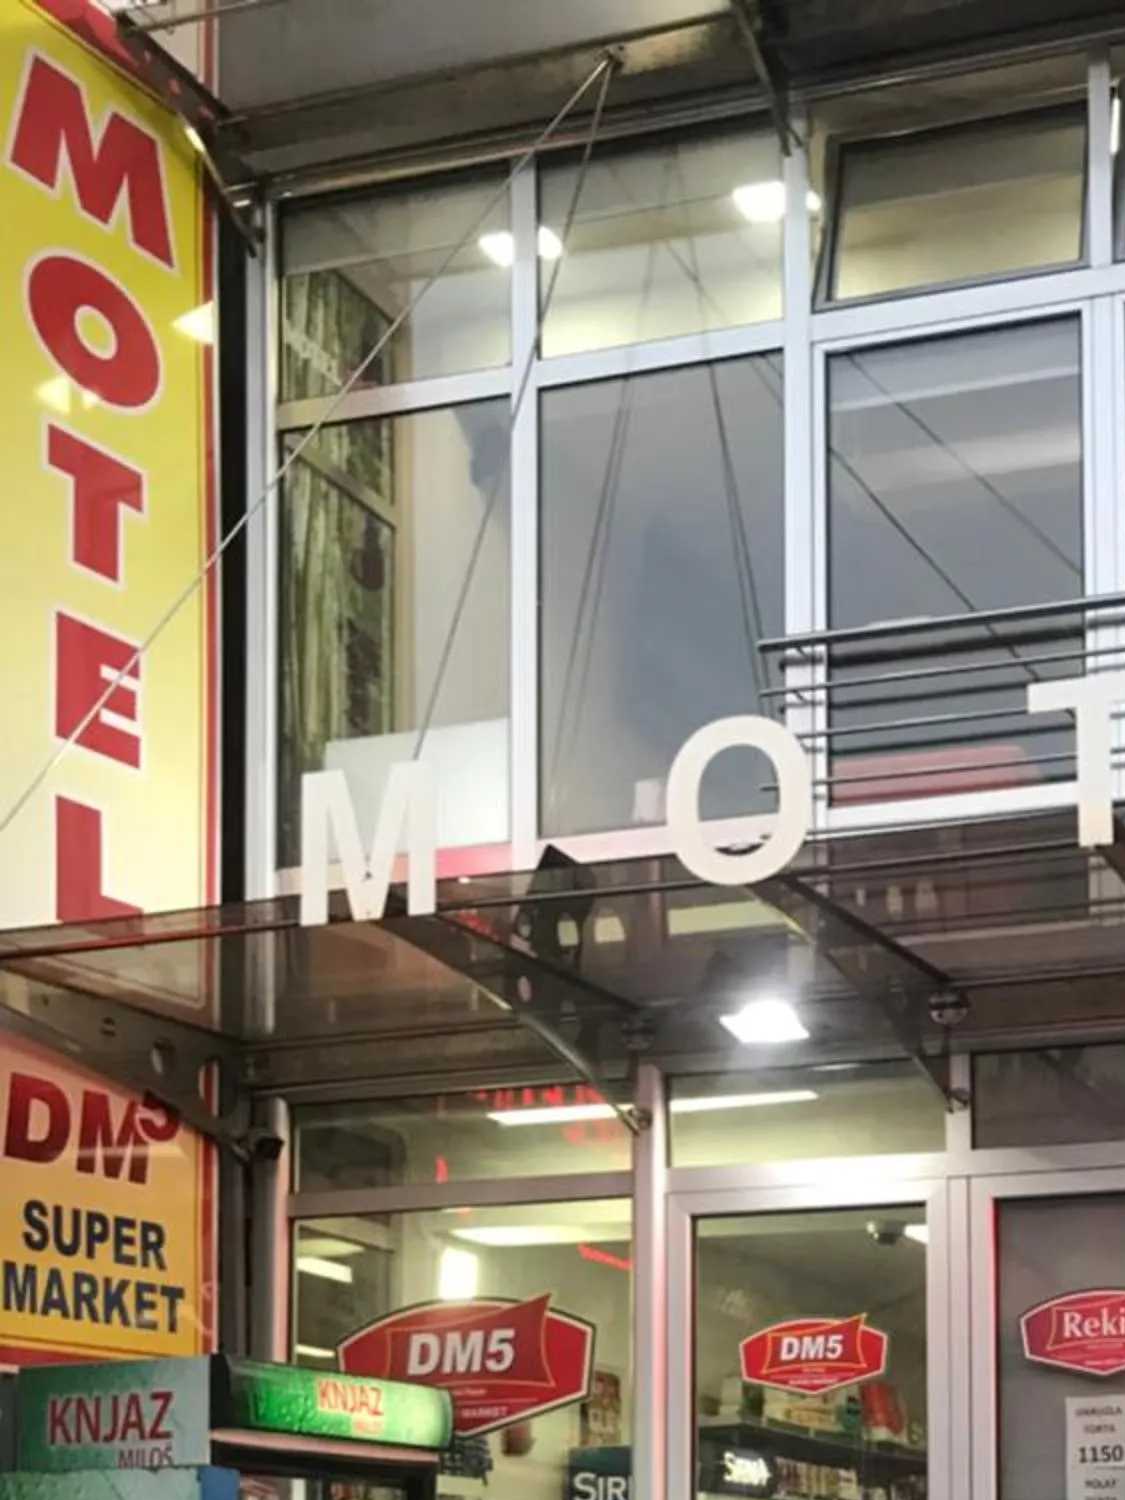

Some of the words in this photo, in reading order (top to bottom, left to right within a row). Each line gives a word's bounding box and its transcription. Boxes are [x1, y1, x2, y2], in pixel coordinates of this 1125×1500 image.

[8, 52, 178, 926] MOTEL
[23, 1199, 167, 1272] SUPER
[2, 1259, 186, 1334] MARKET
[407, 1327, 516, 1377] DM5
[780, 1334, 844, 1361] DM5
[49, 1390, 174, 1445] KNJAZ
[317, 1378, 385, 1417] KNJAZ
[118, 1444, 174, 1469] MILOŠ
[1078, 1444, 1125, 1464] 1150
